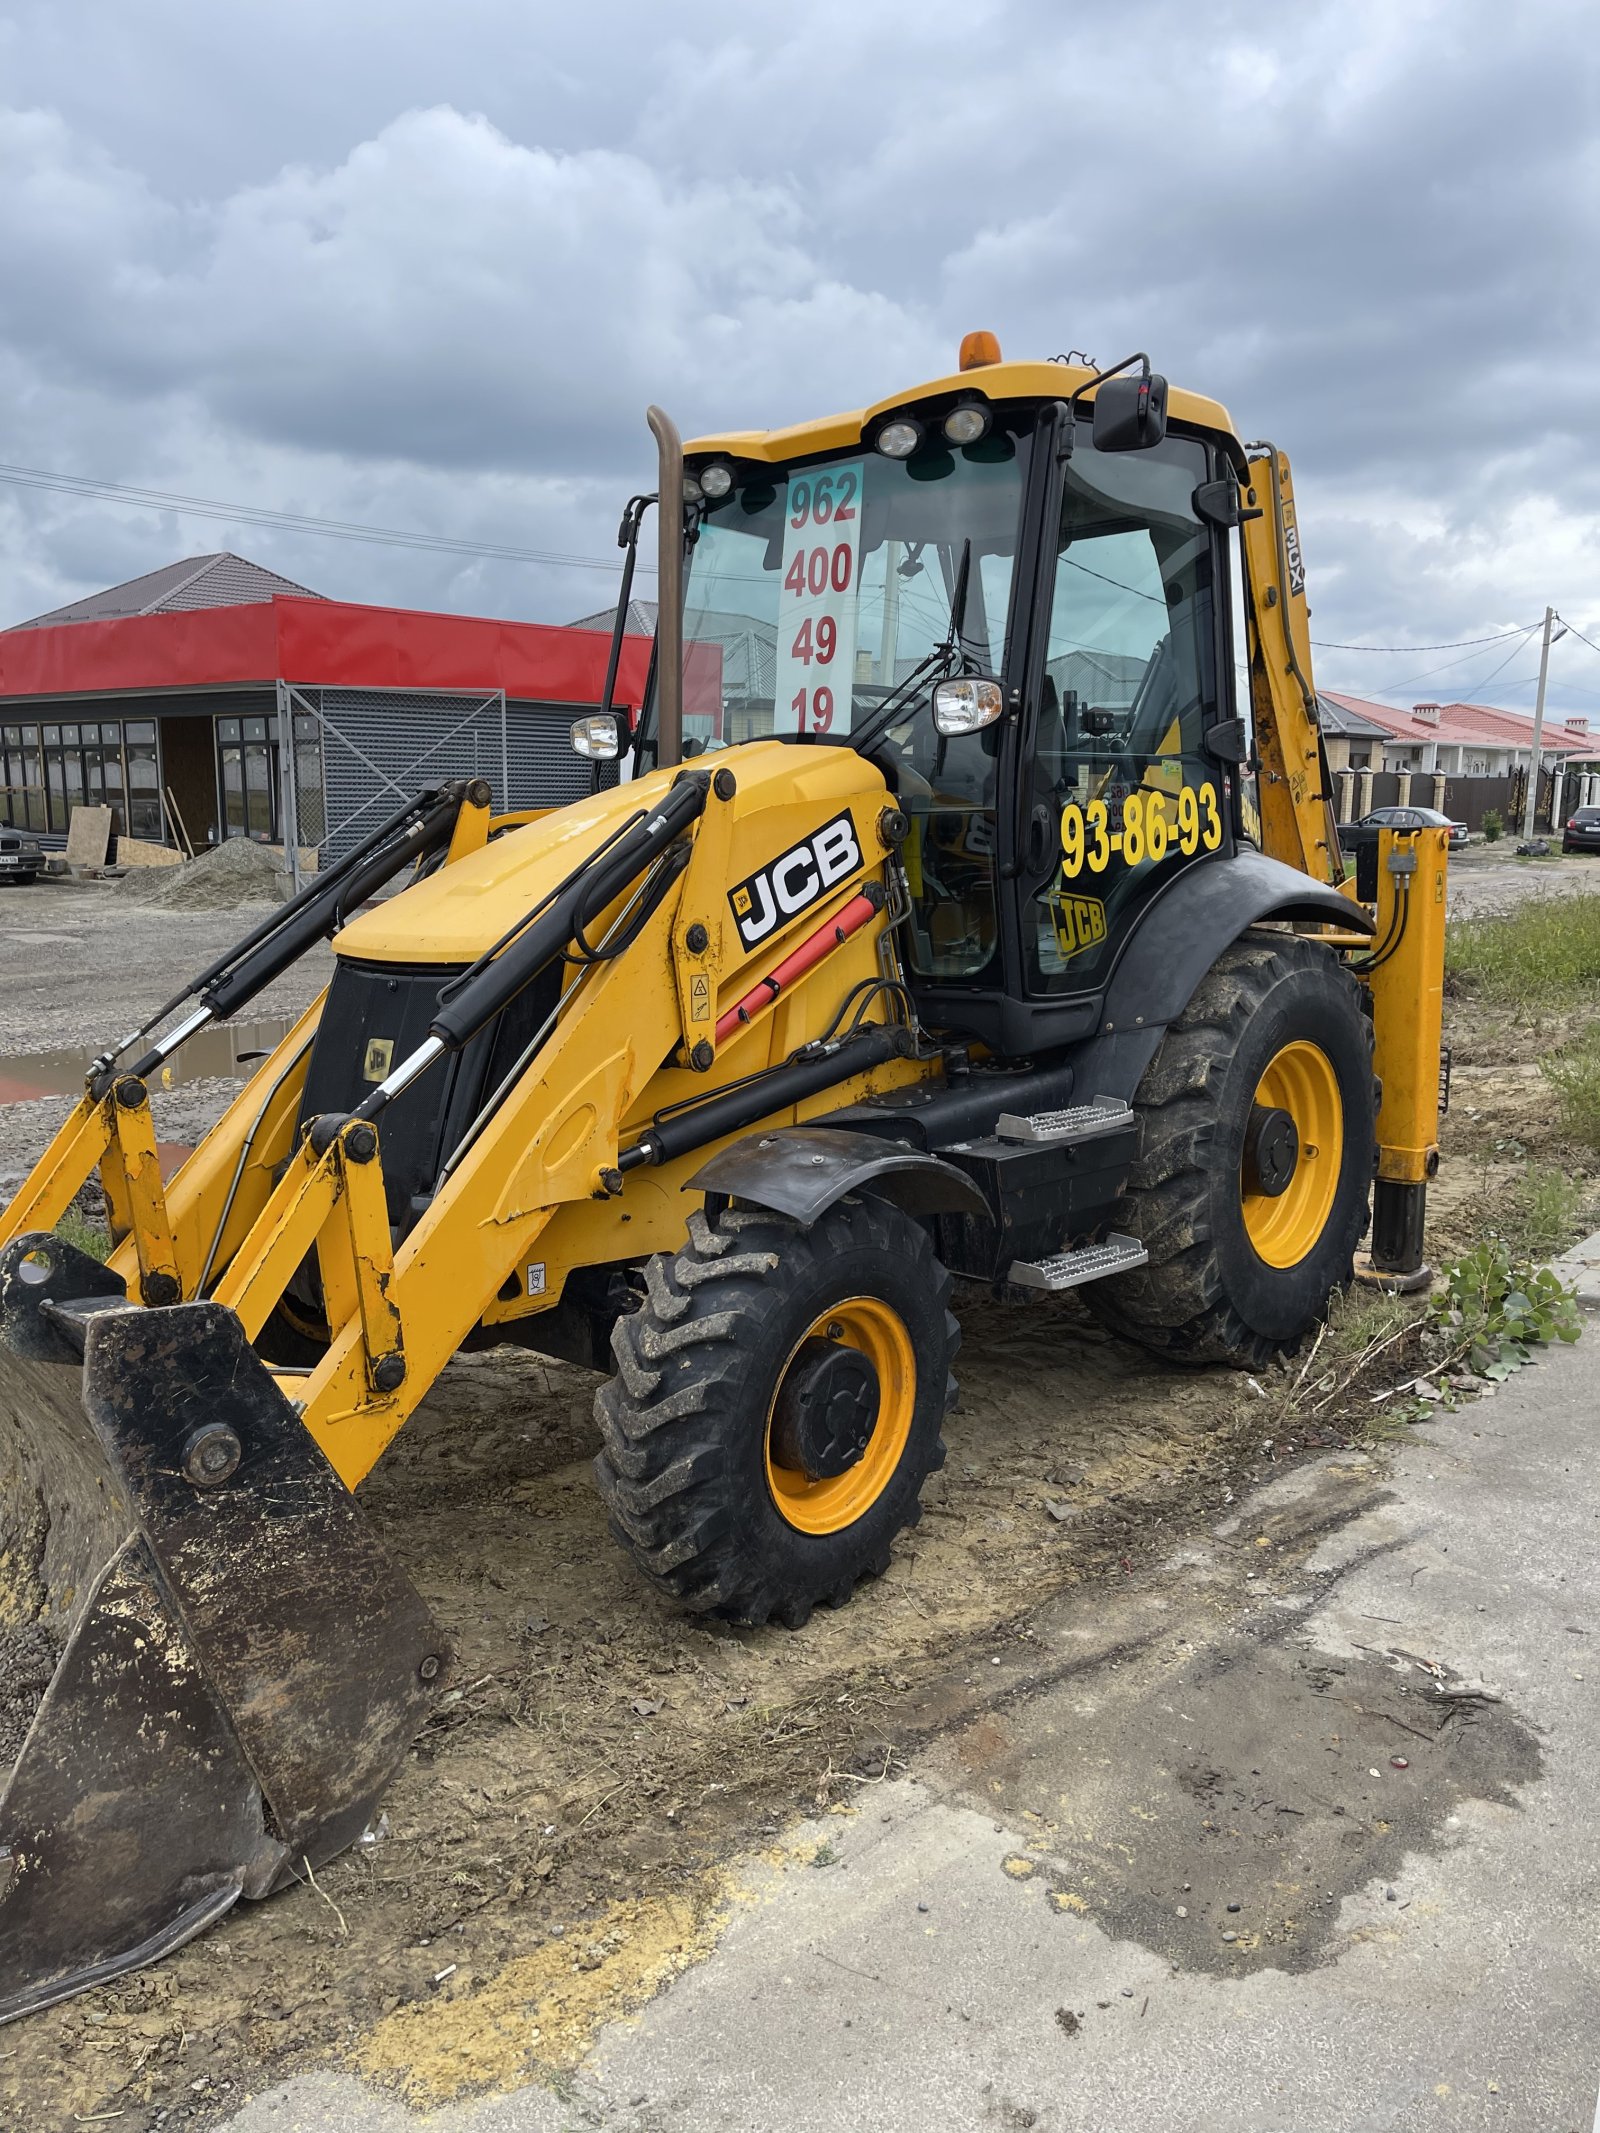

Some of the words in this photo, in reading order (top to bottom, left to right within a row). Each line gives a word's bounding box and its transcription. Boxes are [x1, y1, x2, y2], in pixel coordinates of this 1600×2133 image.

[790, 471, 857, 530] 962
[784, 542, 852, 597] 400
[1286, 527, 1303, 588] 3CX
[791, 615, 837, 665] 49
[791, 686, 834, 734] 19
[1060, 781, 1221, 878] 93-86-93
[741, 819, 859, 942] JCB
[1058, 898, 1104, 954] JCB
